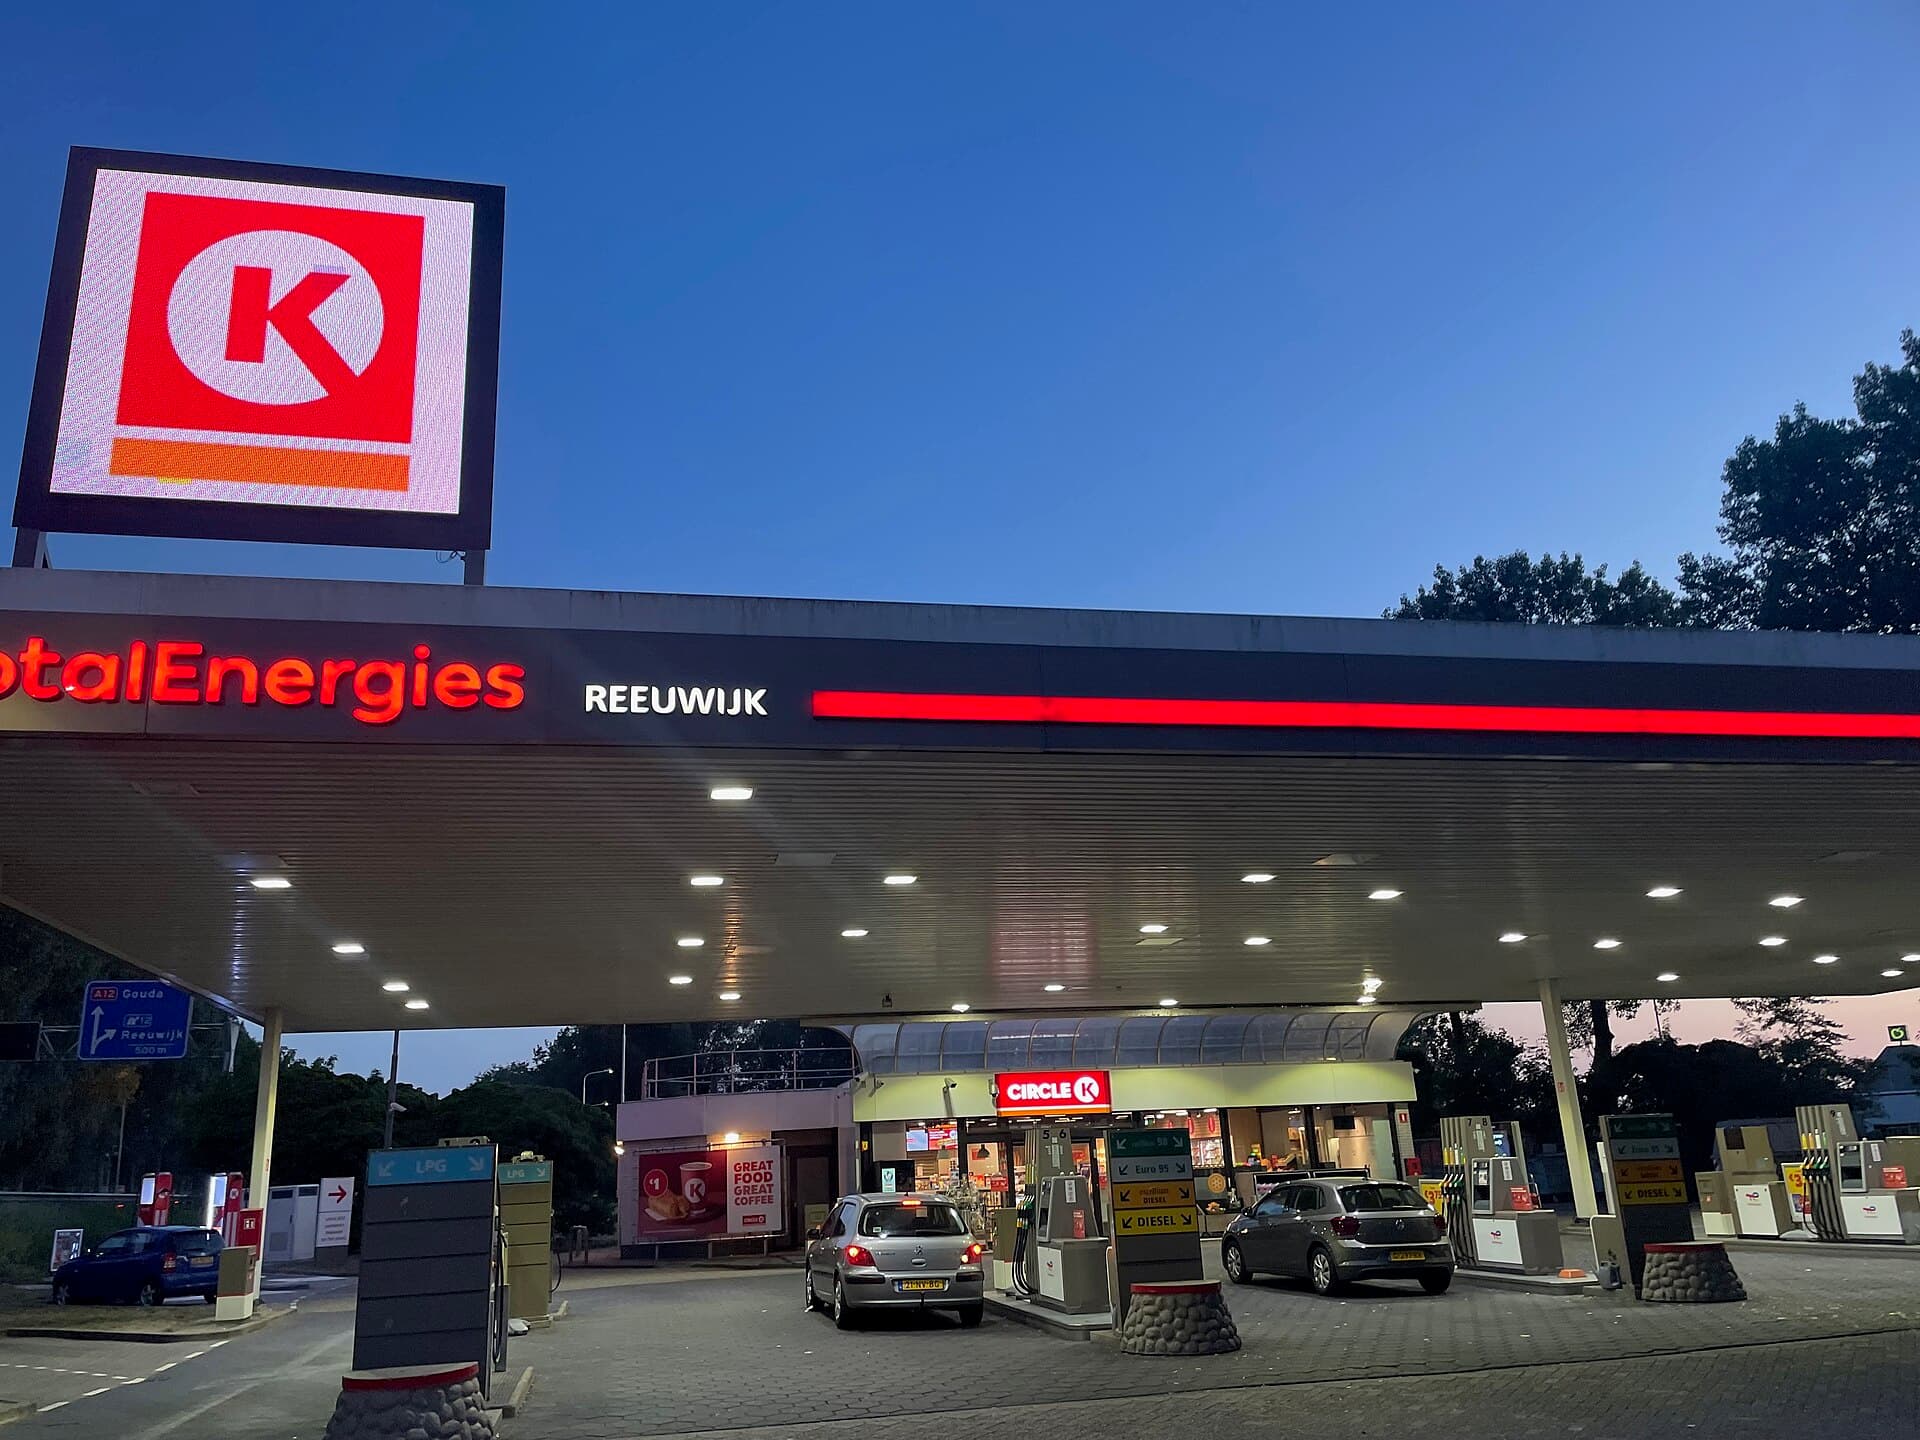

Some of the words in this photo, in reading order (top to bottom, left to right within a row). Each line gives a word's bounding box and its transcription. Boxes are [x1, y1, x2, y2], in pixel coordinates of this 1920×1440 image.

[221, 259, 364, 400] K
[585, 684, 768, 715] REEUWIJK
[93, 989, 116, 998] A12
[122, 988, 164, 999] Gouda
[121, 1029, 183, 1041] Reeuwijk
[135, 1046, 155, 1055] 500
[157, 1046, 167, 1054] m
[1007, 1082, 1072, 1100] CIRCLE
[1080, 1080, 1098, 1103] K
[1467, 1118, 1472, 1127] 7
[1482, 1118, 1488, 1126] 8
[1043, 1130, 1049, 1139] 5
[1060, 1129, 1066, 1138] 6
[416, 1159, 447, 1174] LPG
[734, 1160, 774, 1173] GREAT
[1136, 1165, 1156, 1174] Euro
[1158, 1164, 1169, 1173] 95
[507, 1169, 525, 1179] LPG
[734, 1171, 773, 1184] FOOD
[688, 1182, 705, 1201] K
[734, 1184, 774, 1196] GREAT
[1637, 1188, 1670, 1198] DIESEL
[735, 1195, 774, 1206] COFFEE
[1143, 1196, 1167, 1204] DIESEL
[1138, 1215, 1176, 1227] DIESEL
